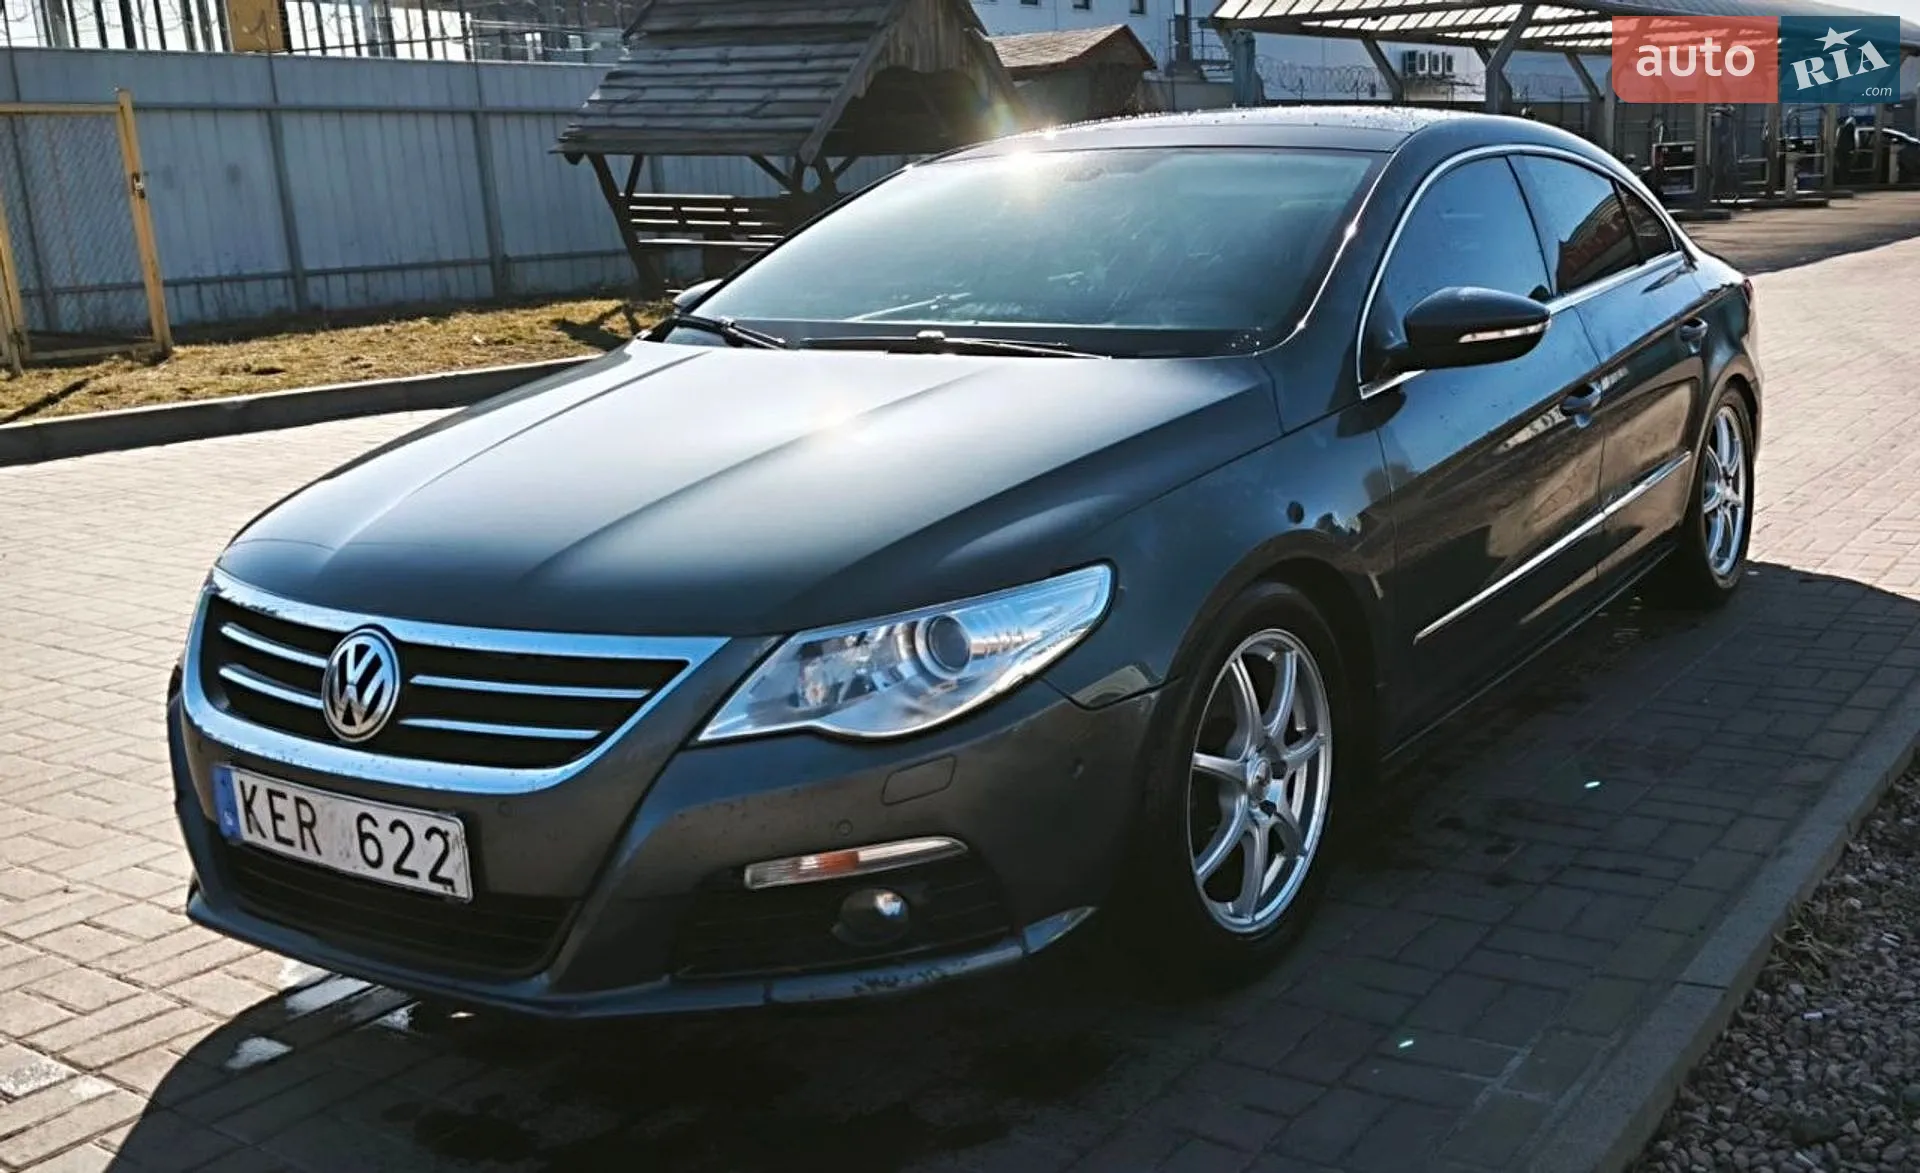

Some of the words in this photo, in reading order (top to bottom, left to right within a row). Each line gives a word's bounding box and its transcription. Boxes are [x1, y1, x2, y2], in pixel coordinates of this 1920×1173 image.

[329, 634, 395, 737] VW
[239, 780, 322, 856] KER
[356, 811, 456, 888] 622
